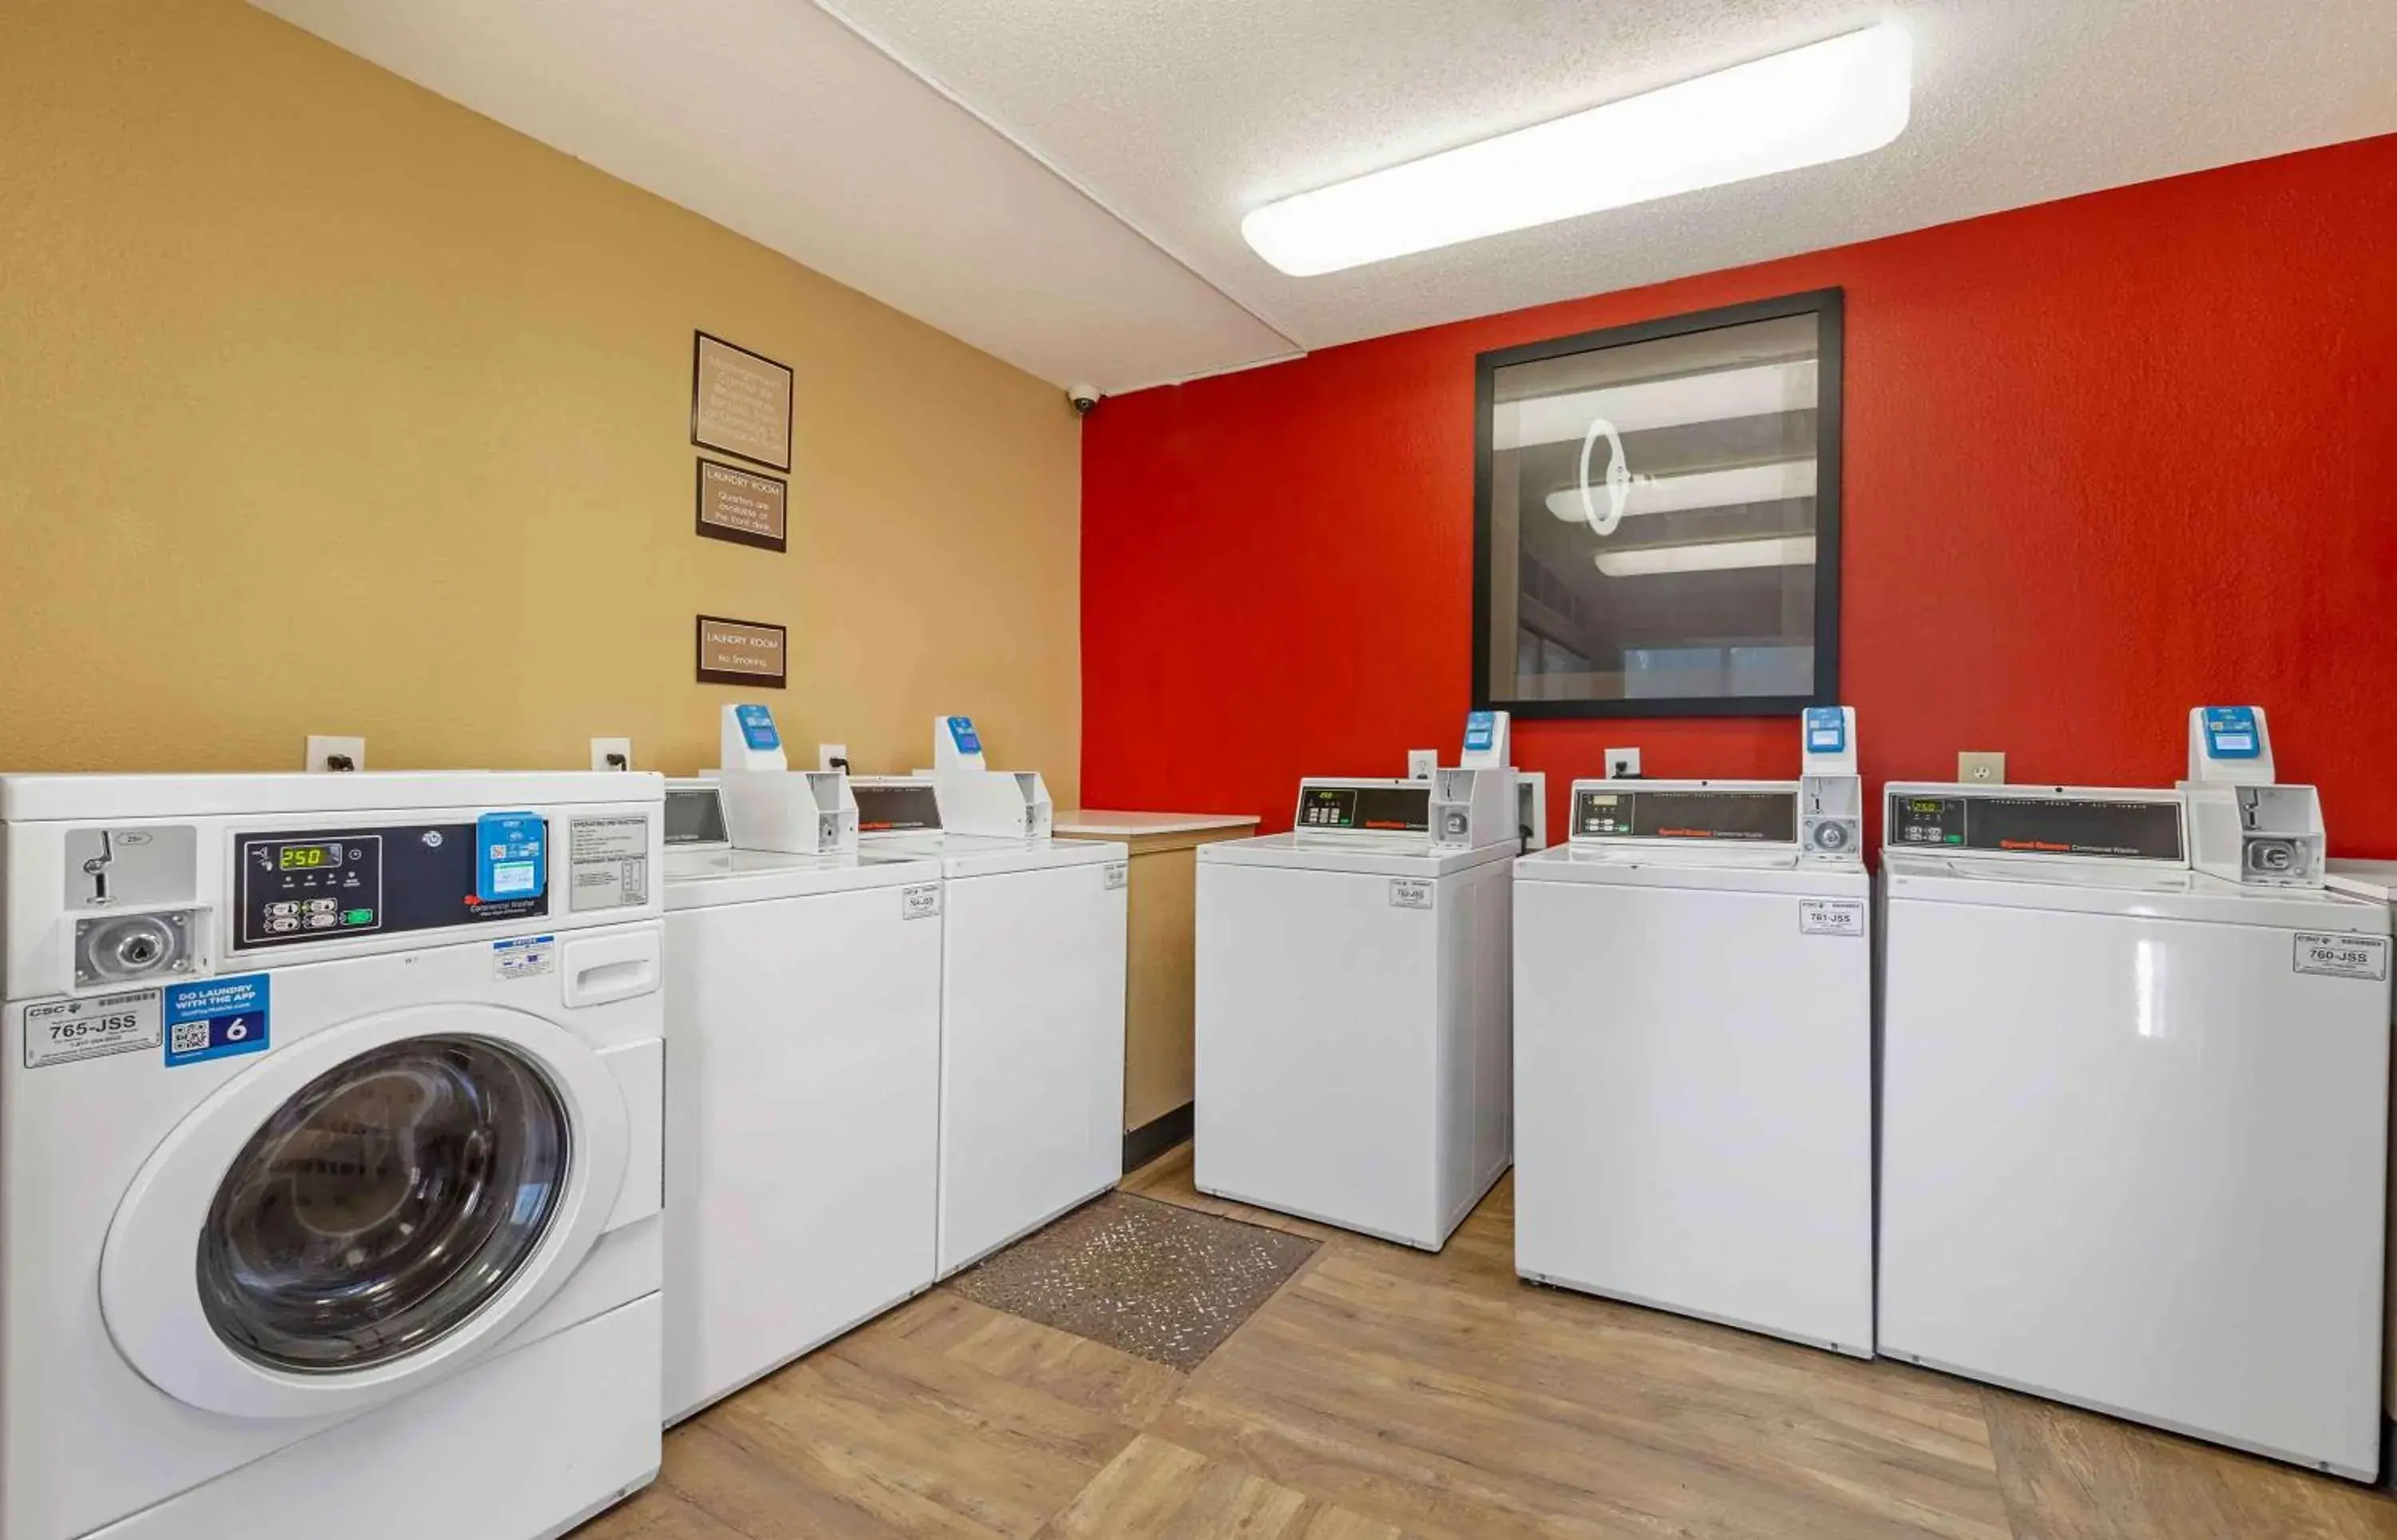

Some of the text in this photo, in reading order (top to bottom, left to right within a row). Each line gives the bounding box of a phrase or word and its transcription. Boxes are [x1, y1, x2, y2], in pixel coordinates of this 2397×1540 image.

[706, 468, 779, 495] LAUNDRY ROOM
[706, 631, 778, 649] LAUNDRY ROOM
[1917, 803, 1936, 812] 250
[1660, 827, 1685, 836] Speed
[1685, 828, 1712, 837] Queen
[281, 849, 320, 867] 250
[1810, 912, 1851, 923] 761-JSS
[2309, 950, 2367, 963] 760-JSS
[175, 998, 207, 1010] WITH
[209, 994, 231, 1005] THE
[233, 991, 256, 1002] APP
[178, 983, 253, 1002] DO LAUNDRY
[29, 1005, 66, 1017] CSC
[49, 1014, 137, 1040] 765-JSS
[226, 1018, 247, 1041] 6
